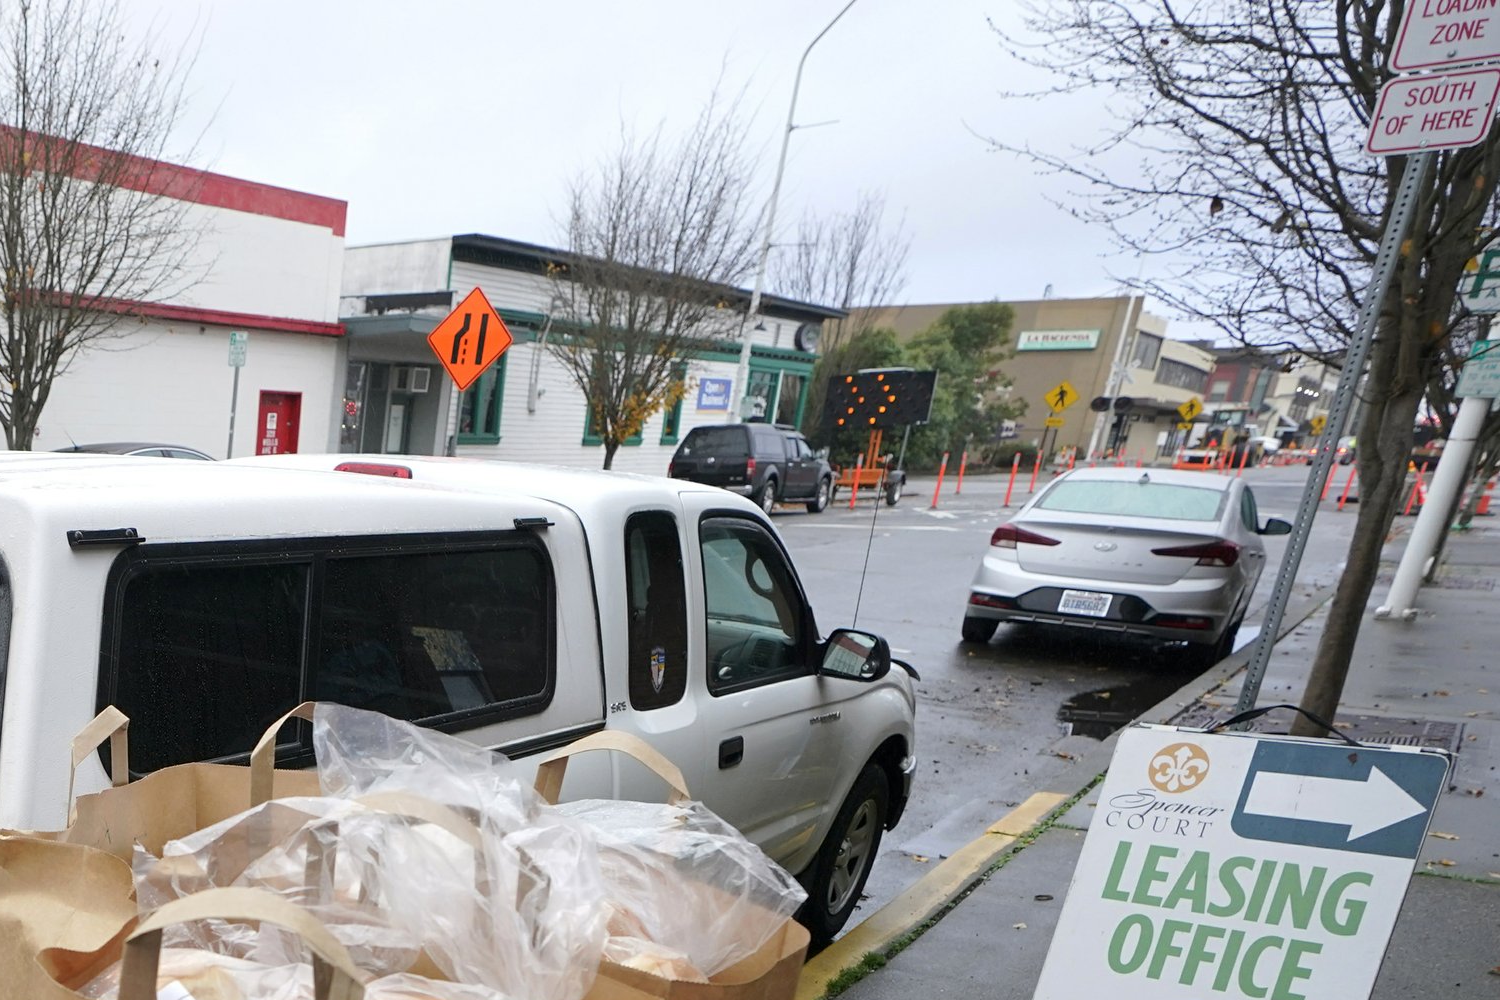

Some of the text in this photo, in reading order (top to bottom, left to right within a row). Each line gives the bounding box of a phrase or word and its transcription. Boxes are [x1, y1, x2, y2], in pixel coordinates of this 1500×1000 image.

[1429, 18, 1490, 45] ZONE
[1404, 81, 1477, 107] SOUTH
[1385, 115, 1414, 135] OF
[1420, 108, 1479, 132] HERE
[1109, 788, 1225, 818] Spencer
[1105, 810, 1213, 838] COURT
[1101, 840, 1374, 936] LEASING
